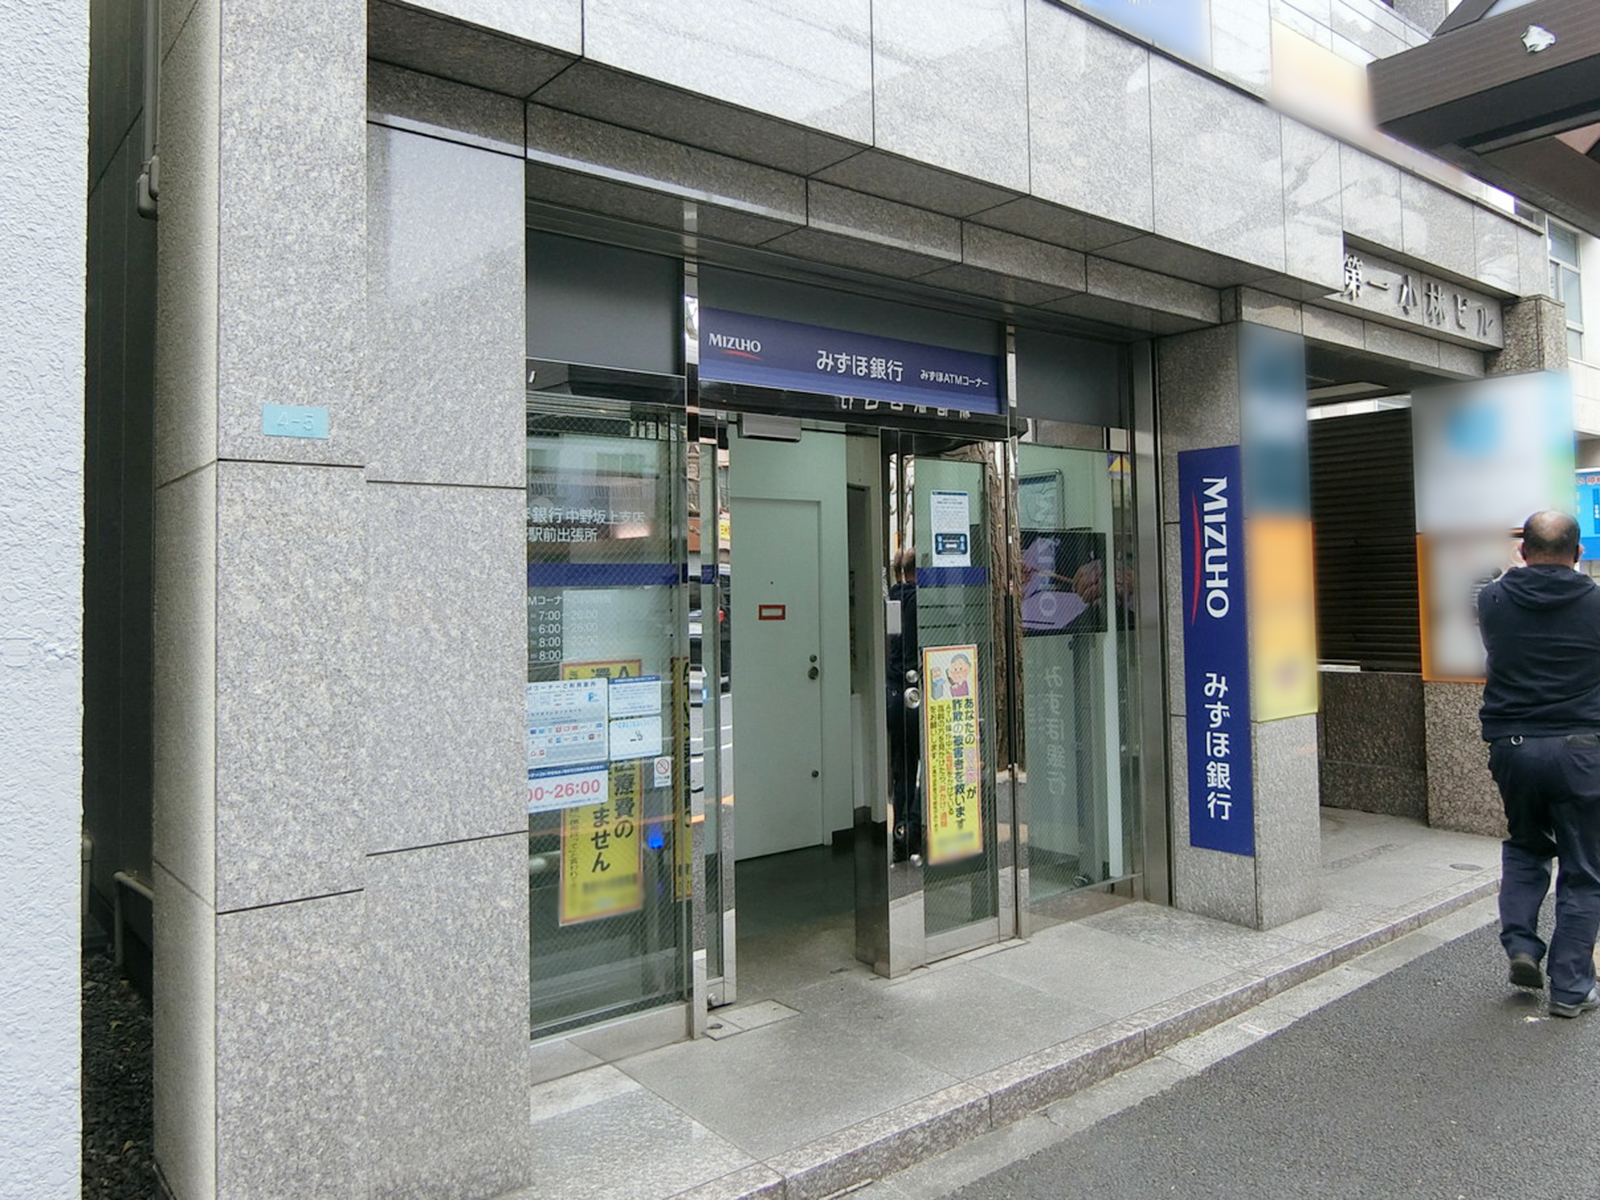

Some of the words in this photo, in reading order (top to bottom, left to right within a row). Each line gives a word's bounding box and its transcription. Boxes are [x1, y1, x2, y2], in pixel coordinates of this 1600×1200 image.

[1341, 253, 1494, 337] 第一小林ビル
[708, 332, 762, 353] MIZUHO
[815, 349, 904, 383] みずほ銀行
[920, 369, 990, 388] みずほATMコーナー
[527, 506, 645, 524] 銀行中野坂上支店
[1202, 475, 1230, 619] MIZUHO
[538, 610, 562, 621] 7:00
[538, 623, 562, 634] 6:00
[538, 636, 562, 648] 8:00
[538, 649, 562, 661] 8:00
[1203, 671, 1233, 821] みずほ銀行
[591, 806, 611, 873] ません
